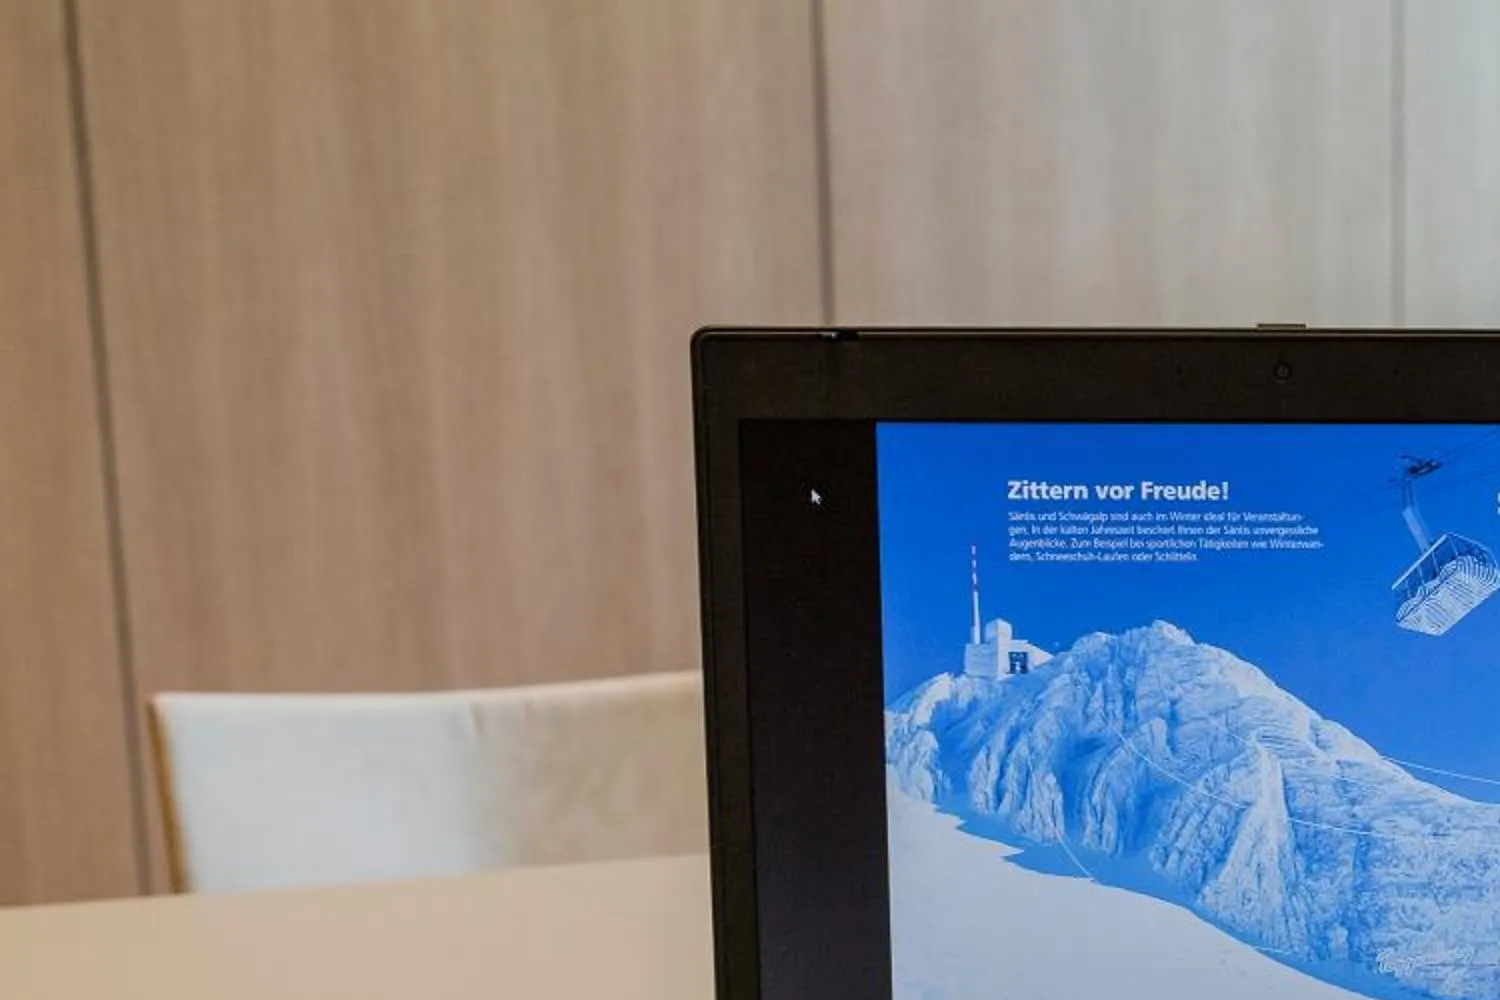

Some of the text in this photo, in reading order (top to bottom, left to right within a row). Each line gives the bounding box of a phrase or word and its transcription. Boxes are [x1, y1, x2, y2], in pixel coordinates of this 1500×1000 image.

[1007, 480, 1229, 500] Zittern vor Freude!
[1038, 512, 1057, 521] und
[1131, 512, 1153, 521] auch
[1042, 525, 1058, 535] der
[1205, 525, 1221, 535] der
[1071, 538, 1092, 549] Zum
[1131, 552, 1153, 561] oder
